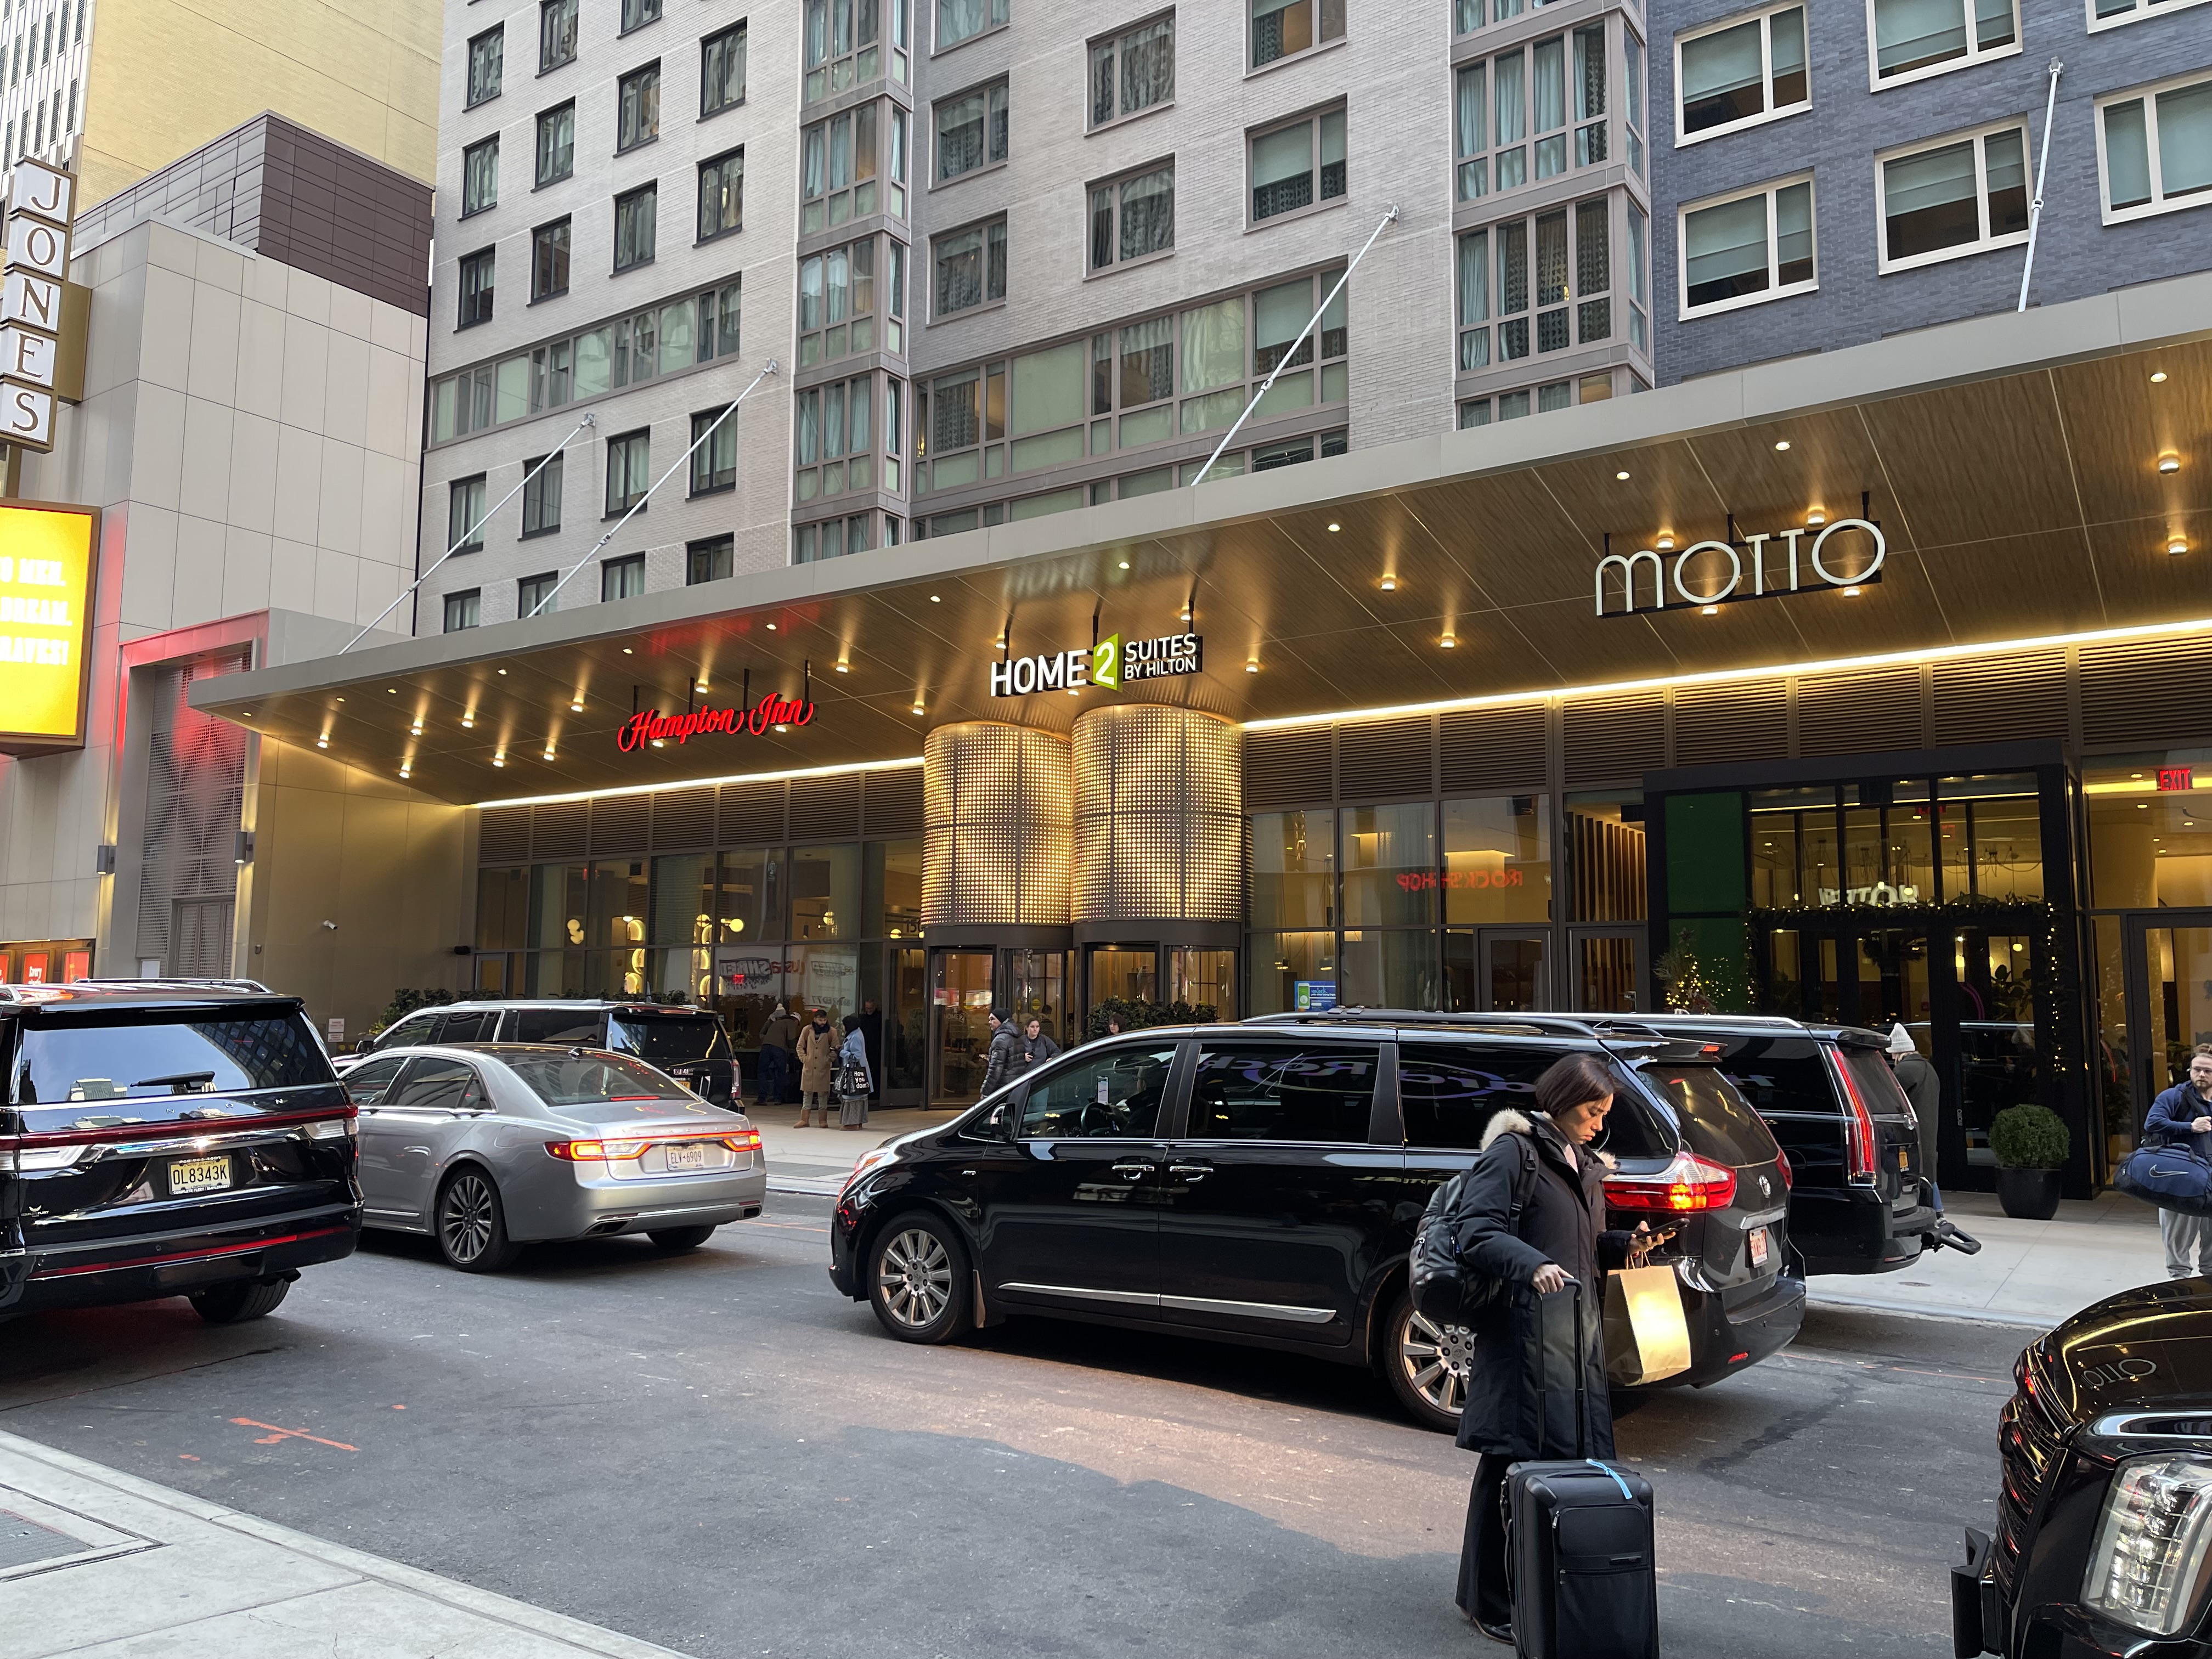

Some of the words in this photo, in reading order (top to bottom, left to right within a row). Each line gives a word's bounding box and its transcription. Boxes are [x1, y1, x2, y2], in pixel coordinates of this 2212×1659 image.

[11, 175, 61, 433] JONES
[1595, 518, 1886, 616] MOTTO
[990, 648, 1088, 697] HOME
[1125, 633, 1197, 662] SUITES
[1125, 664, 1142, 680] BY
[1146, 655, 1197, 677] HILTON
[617, 704, 745, 752] Hampton
[748, 692, 815, 736] Inn
[2160, 769, 2191, 791] EXIT
